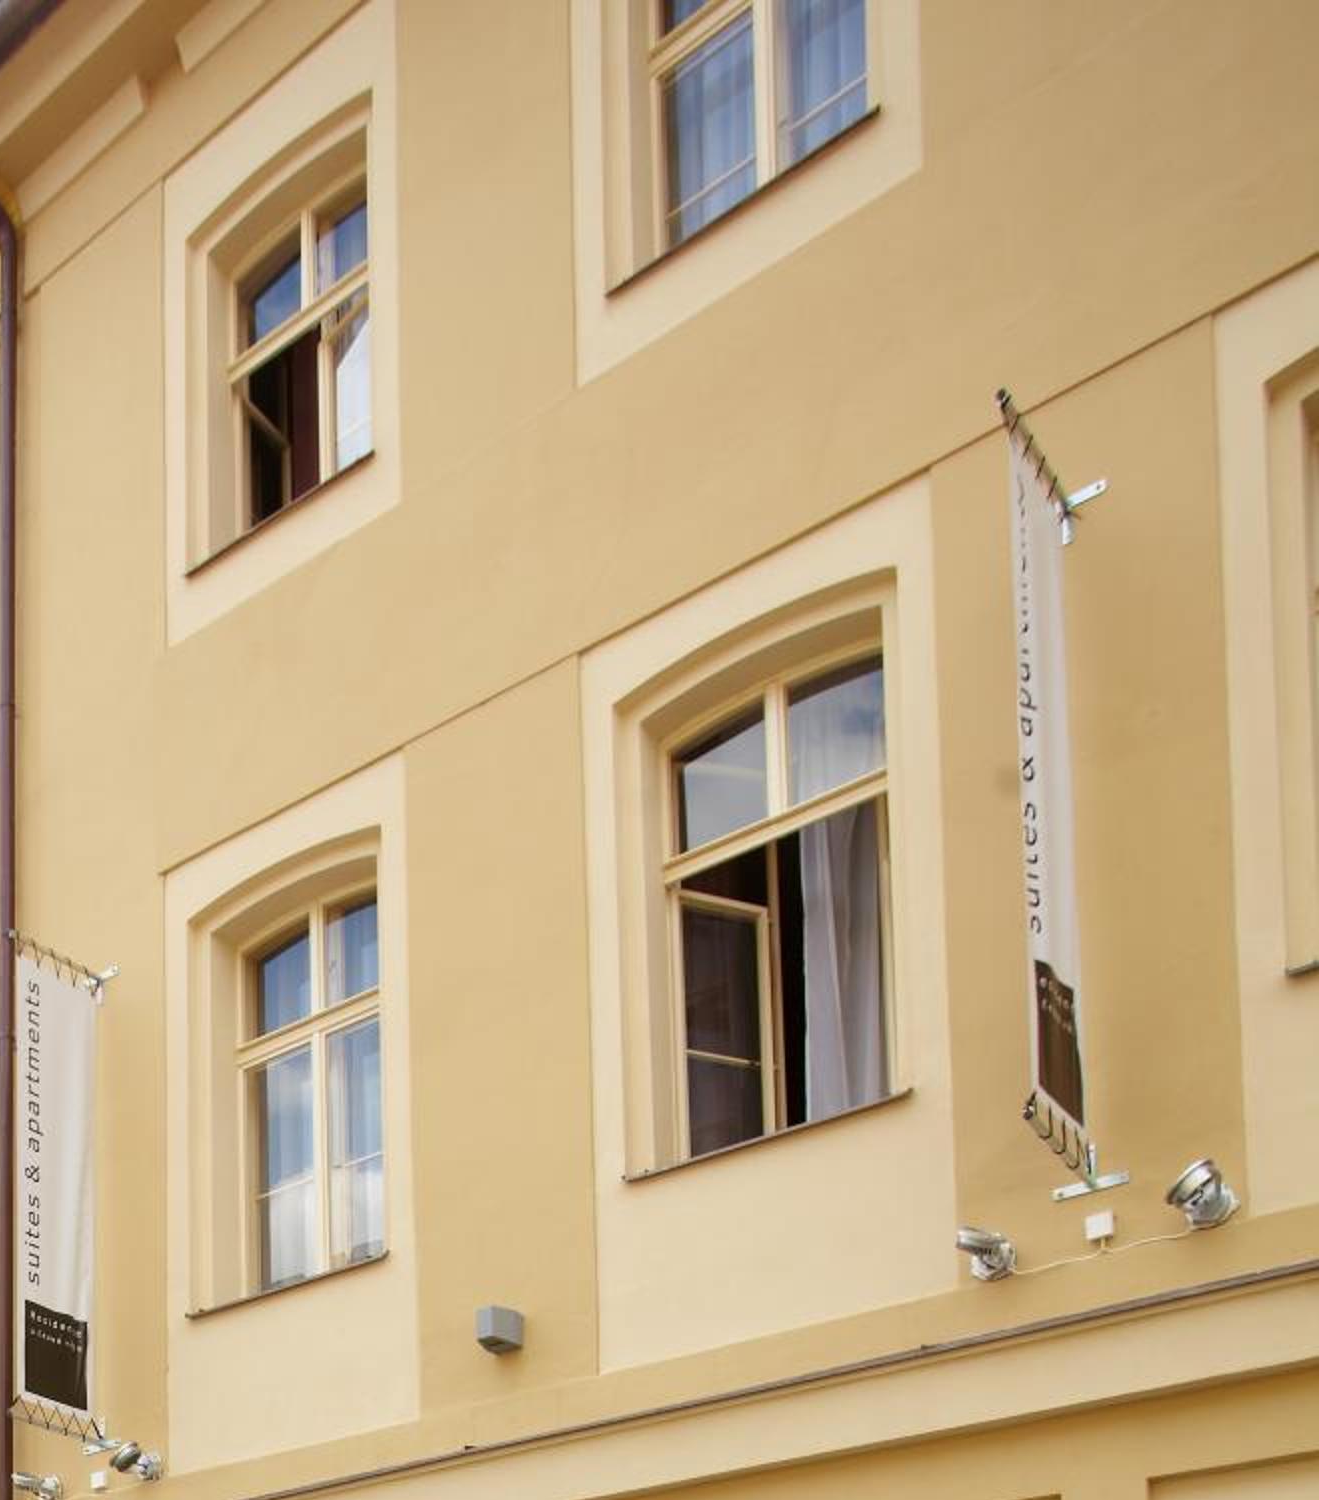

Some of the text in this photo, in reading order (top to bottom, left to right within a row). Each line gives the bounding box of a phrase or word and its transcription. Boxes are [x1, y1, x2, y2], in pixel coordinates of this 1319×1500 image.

[24, 980, 41, 1286] suites & apartments
